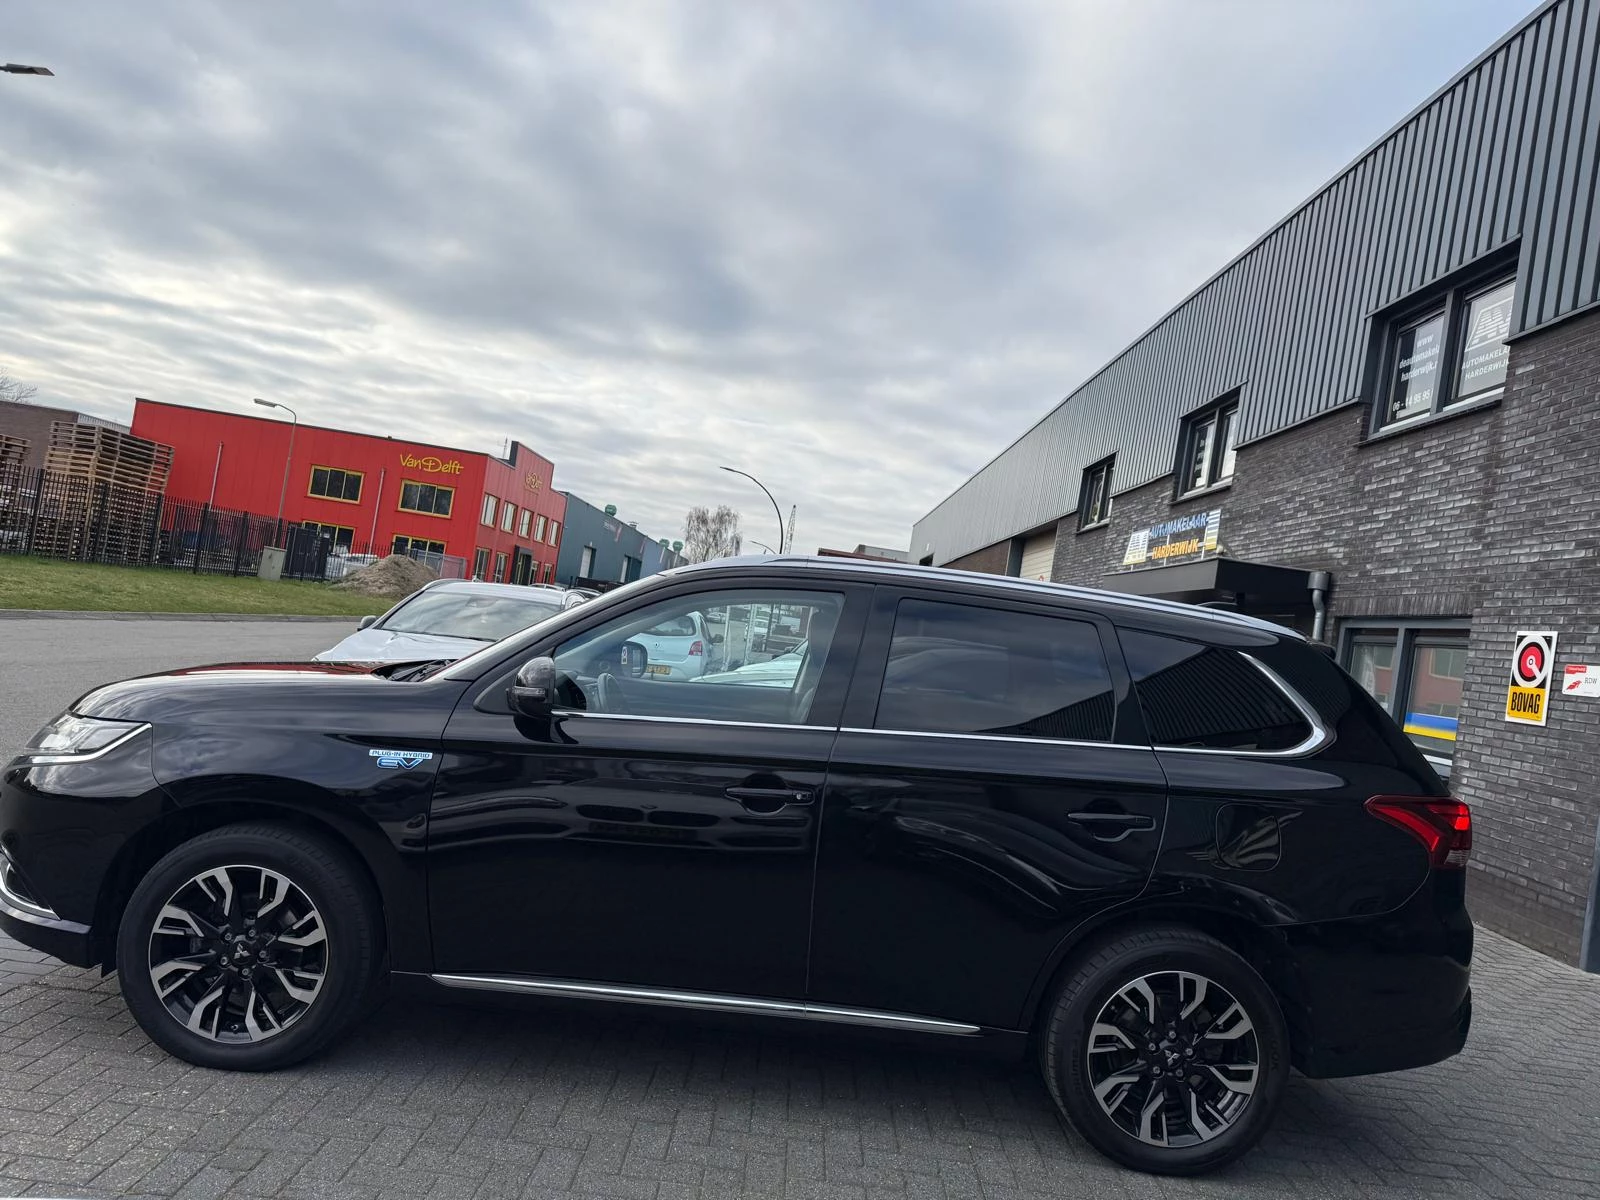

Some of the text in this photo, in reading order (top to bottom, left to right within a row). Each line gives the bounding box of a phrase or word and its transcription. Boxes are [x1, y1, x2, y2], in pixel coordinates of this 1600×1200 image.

[1149, 512, 1208, 539] AUTOMAKELAAR
[1152, 538, 1199, 559] HARDERWIJK
[1584, 677, 1598, 685] RDW
[1510, 692, 1541, 714] BOVAG
[377, 756, 424, 769] EV
